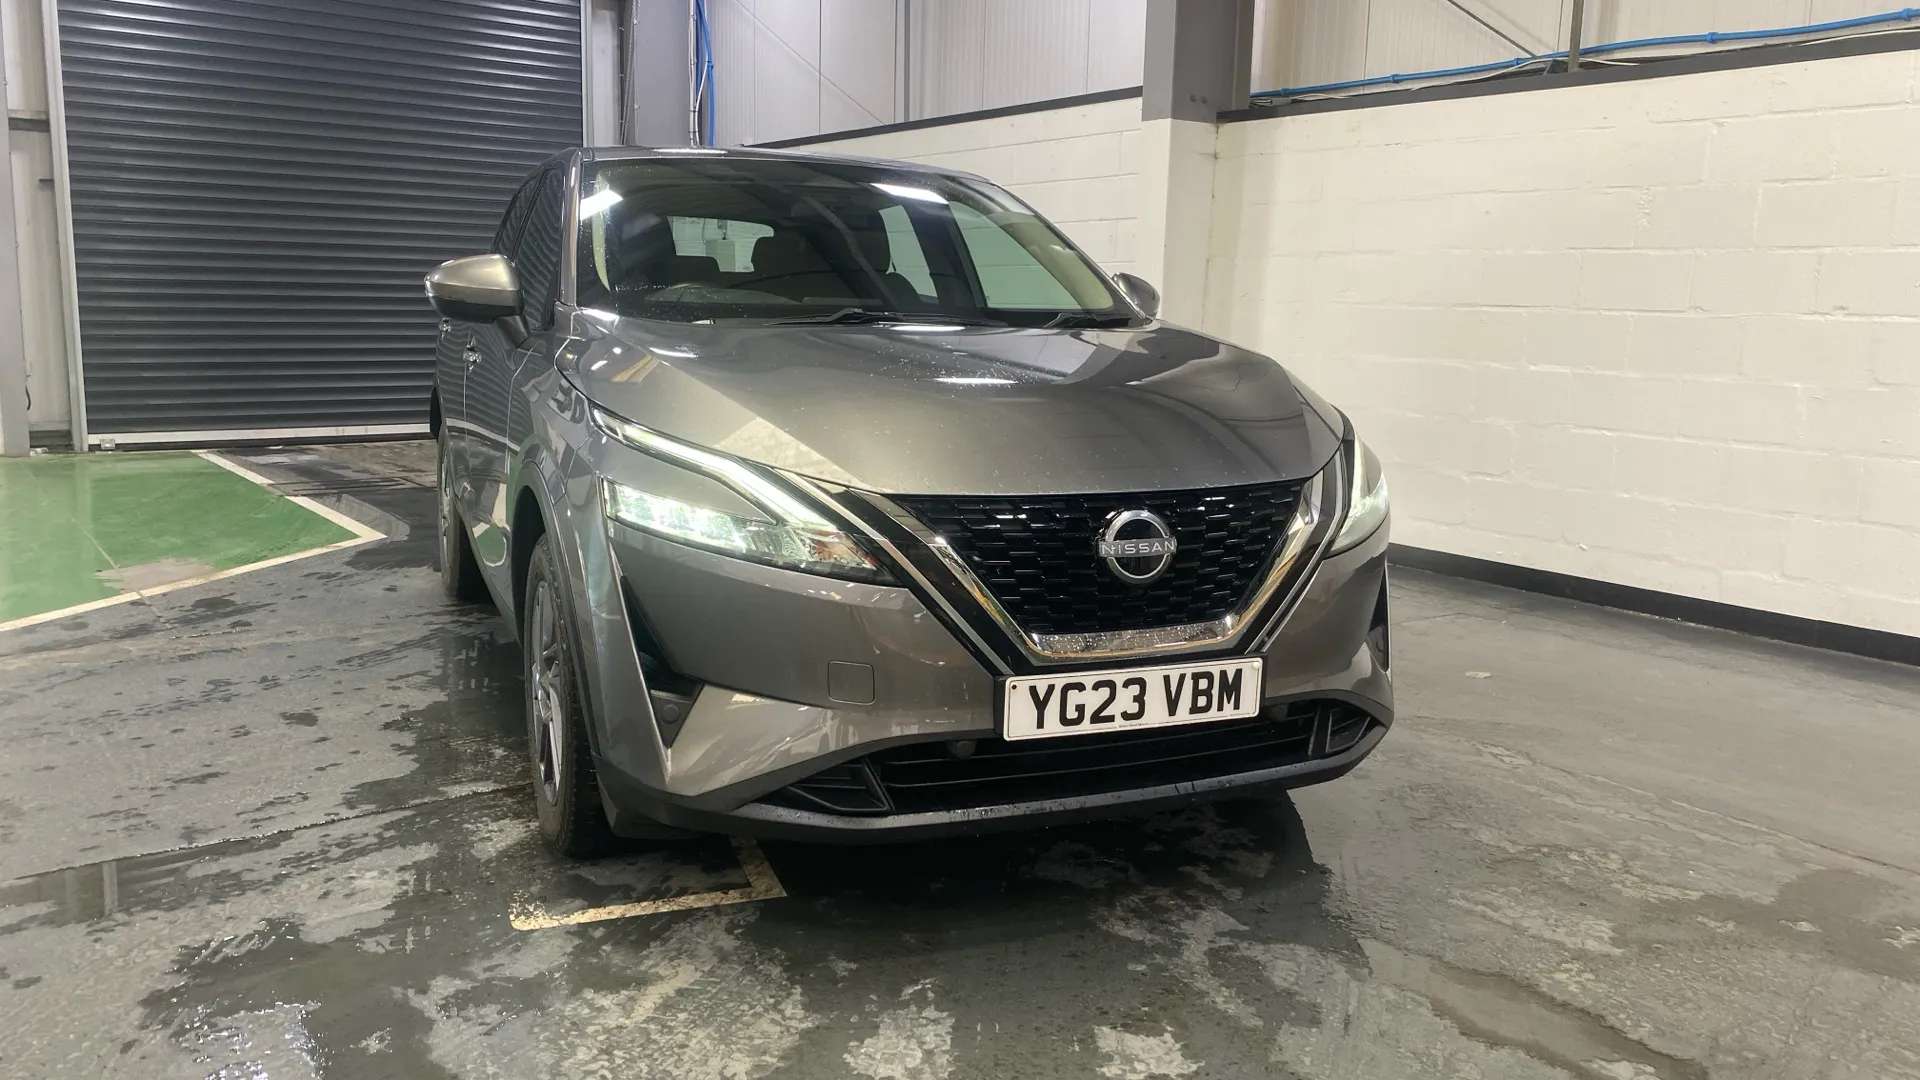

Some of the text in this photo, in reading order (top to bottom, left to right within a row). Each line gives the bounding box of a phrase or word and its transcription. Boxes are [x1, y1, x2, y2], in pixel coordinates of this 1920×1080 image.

[1101, 540, 1175, 555] NISSAN
[1029, 668, 1243, 729] YG23 VBM
